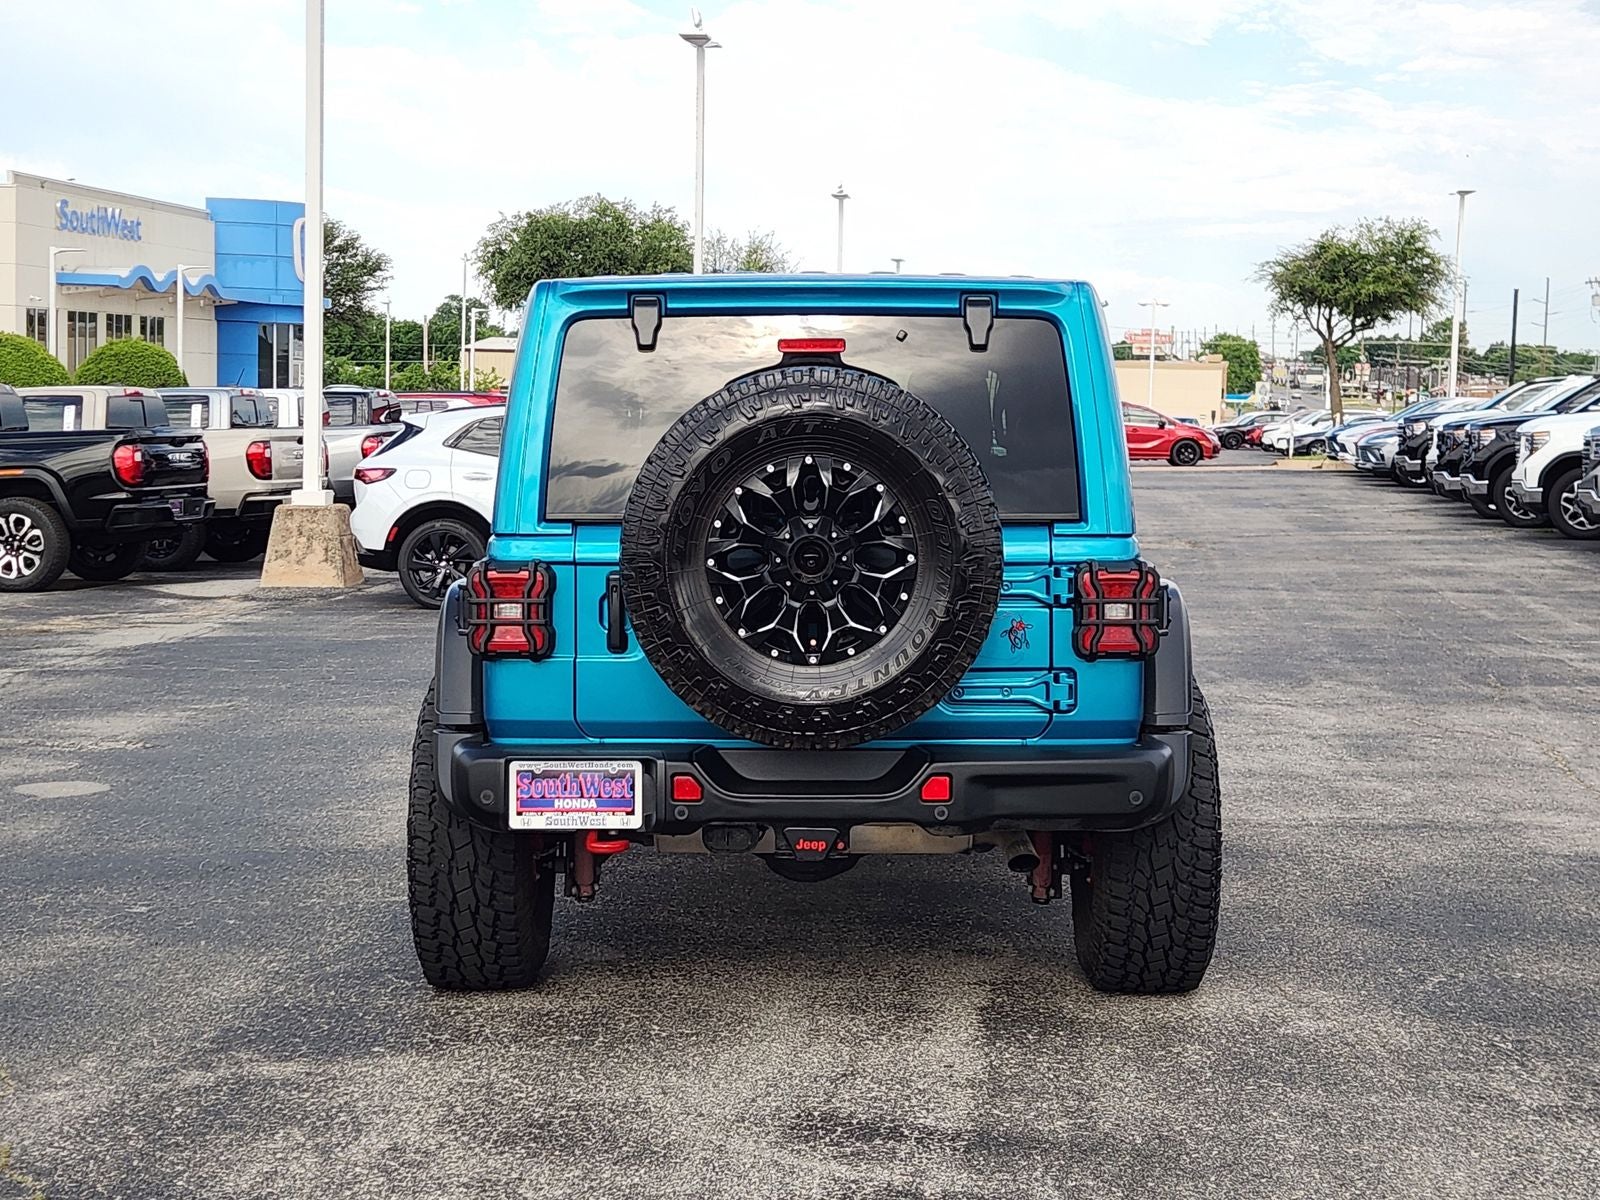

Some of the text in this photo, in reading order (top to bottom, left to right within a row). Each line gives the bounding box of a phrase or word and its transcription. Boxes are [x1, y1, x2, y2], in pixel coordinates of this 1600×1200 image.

[55, 198, 142, 242] SouthWest
[805, 605, 942, 700] COUNTRY
[554, 799, 598, 809] HONDA
[795, 838, 826, 851] Jeep
